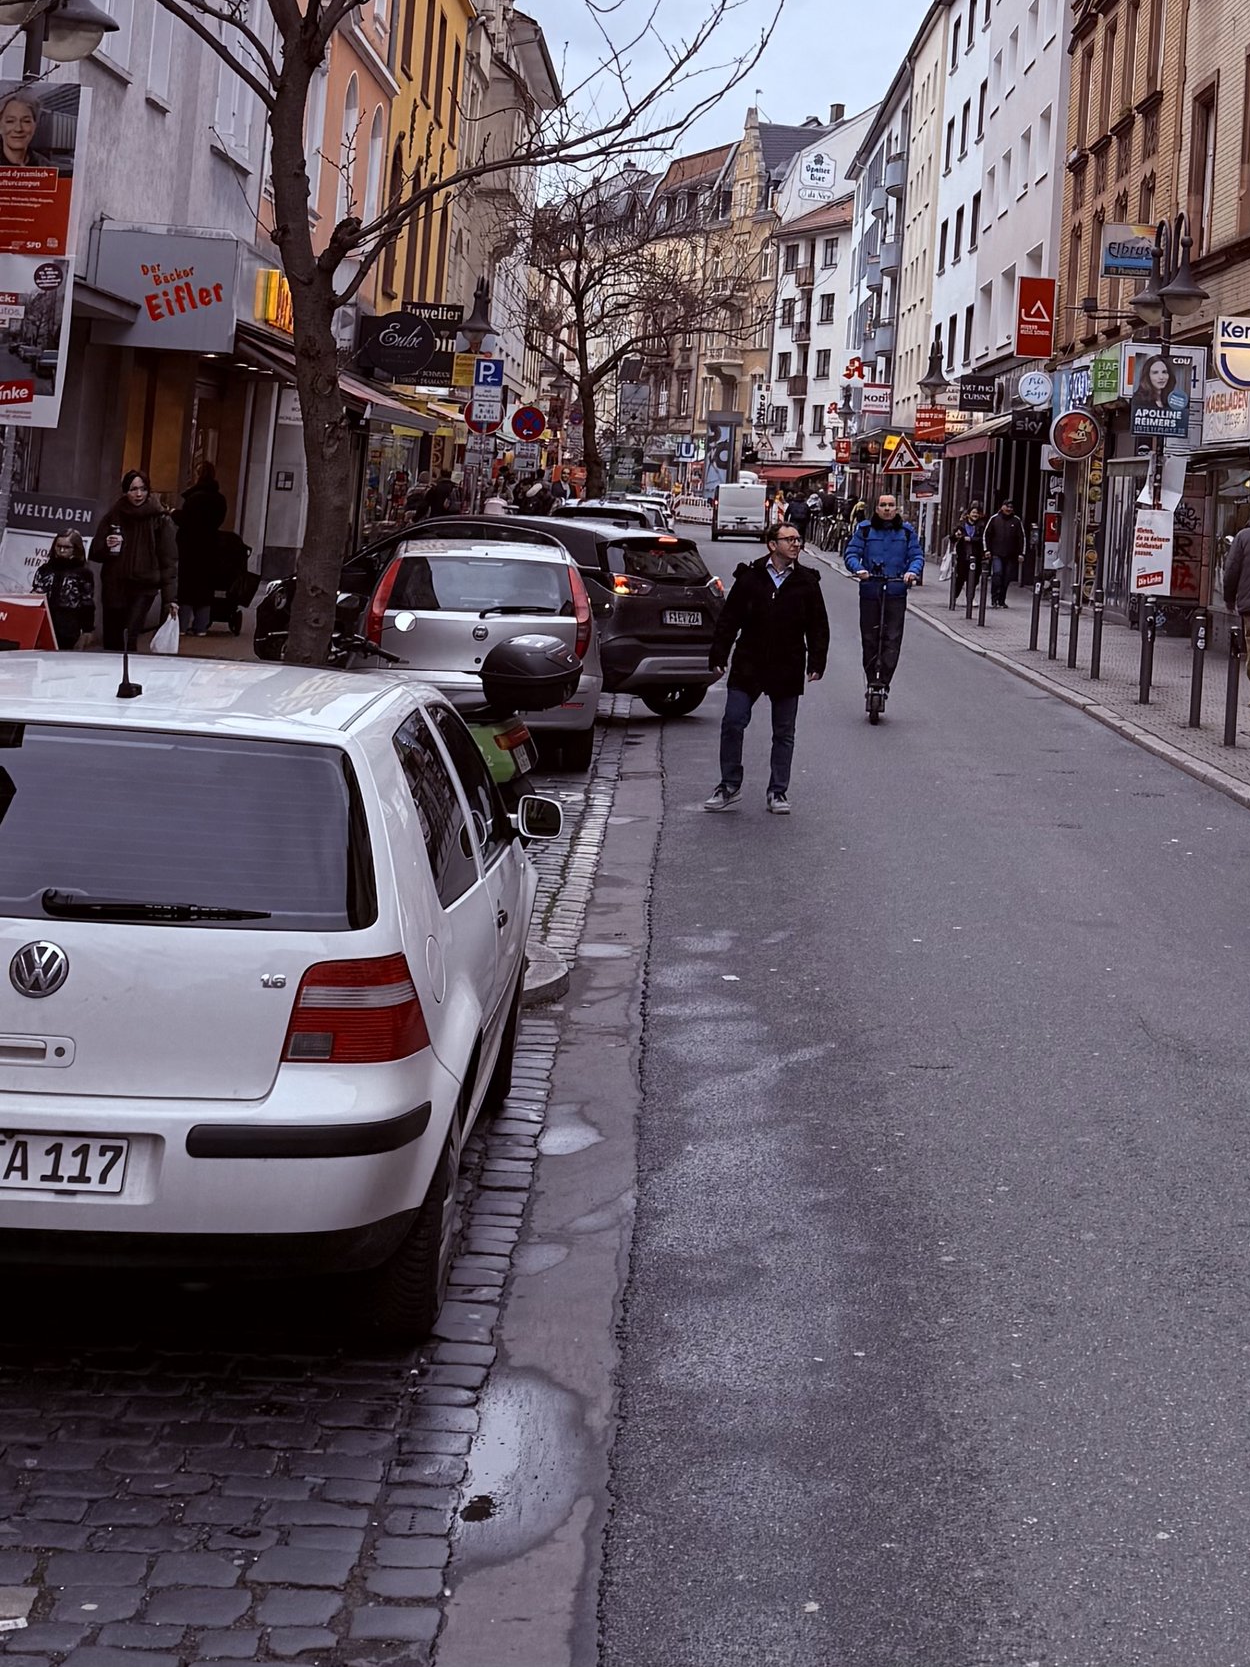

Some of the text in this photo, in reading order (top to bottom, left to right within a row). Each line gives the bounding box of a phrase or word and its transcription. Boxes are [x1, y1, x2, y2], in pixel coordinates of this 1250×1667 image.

[1108, 241, 1152, 258] Elbrus
[141, 263, 160, 276] Der
[153, 266, 194, 286] Bäcker
[145, 282, 223, 322] Eifler
[1099, 362, 1118, 370] HAP
[1172, 357, 1191, 365] CDU
[478, 361, 496, 383] P
[1097, 371, 1111, 379] PY
[1097, 379, 1117, 389] BET
[1135, 409, 1182, 420] APOLLINE
[1015, 416, 1043, 434] sky
[1134, 417, 1176, 428] REIMERS
[14, 502, 92, 523] WELTLADEN
[40, 1142, 124, 1184] 117
